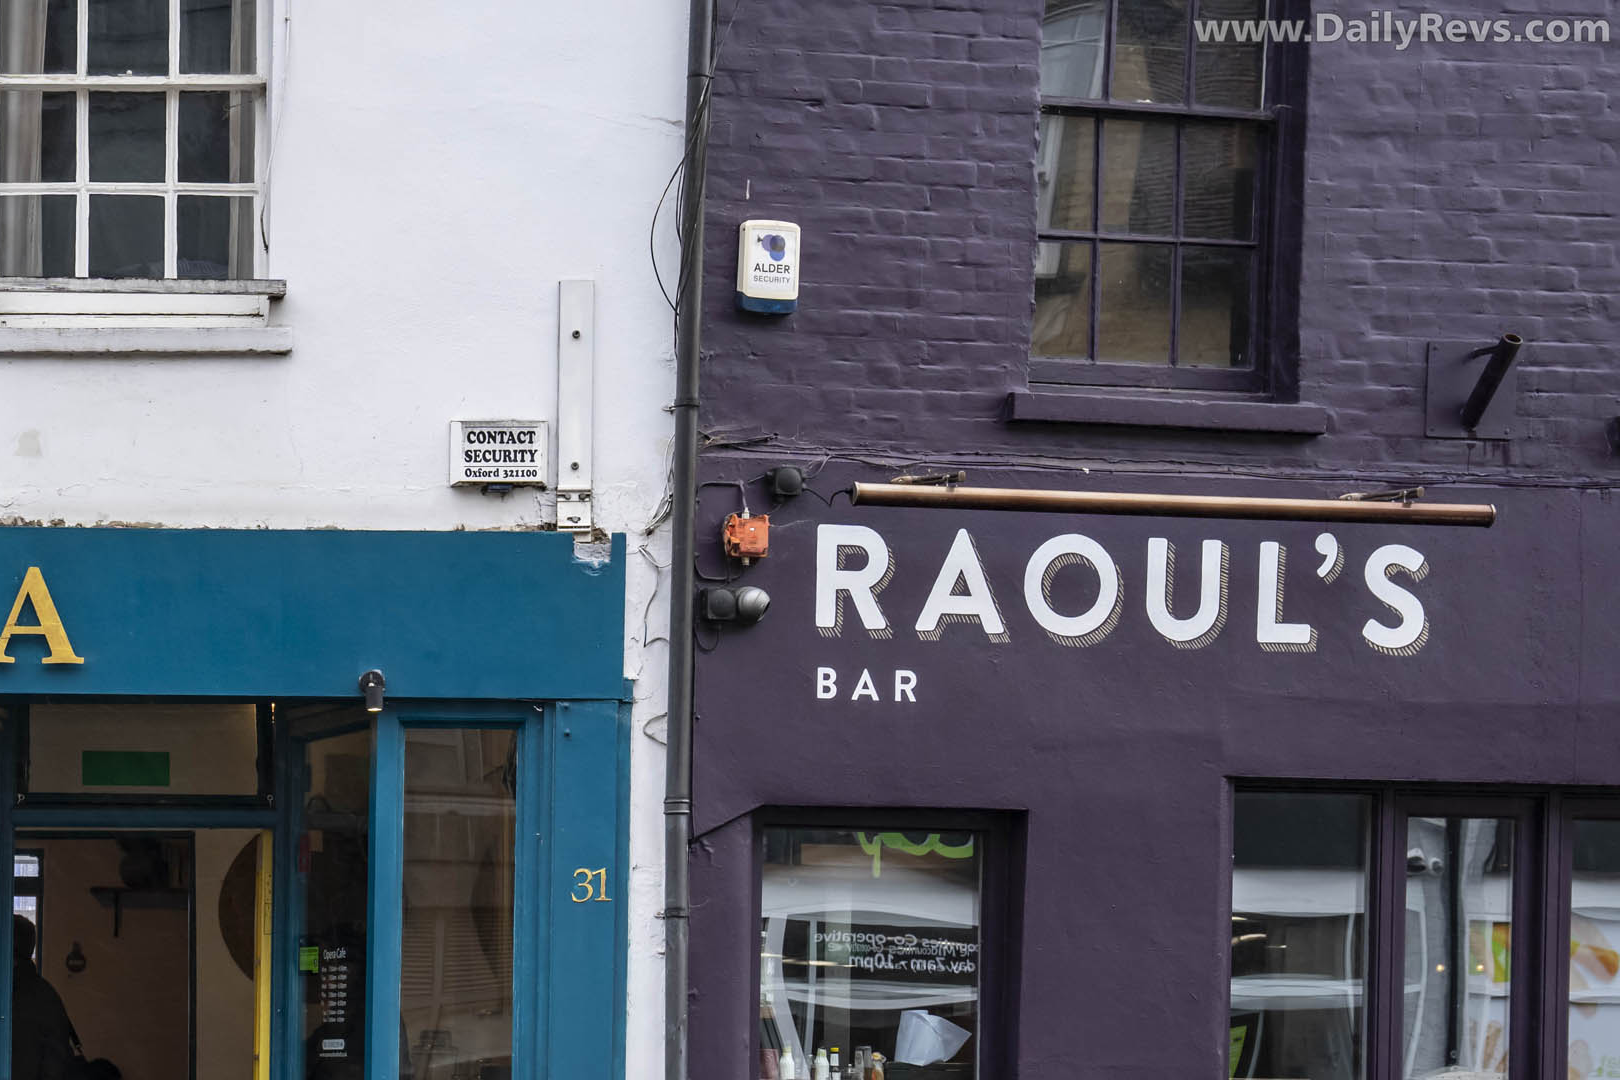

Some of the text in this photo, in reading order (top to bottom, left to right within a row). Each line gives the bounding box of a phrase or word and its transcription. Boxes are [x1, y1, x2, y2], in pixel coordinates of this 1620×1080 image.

[753, 263, 791, 274] ALDER
[753, 275, 791, 284] SECURITY
[466, 430, 536, 444] CONTACT
[464, 449, 538, 463] SECURITY
[464, 467, 538, 479] Oxford 321100
[816, 667, 917, 702] BAR
[571, 867, 613, 903] 31
